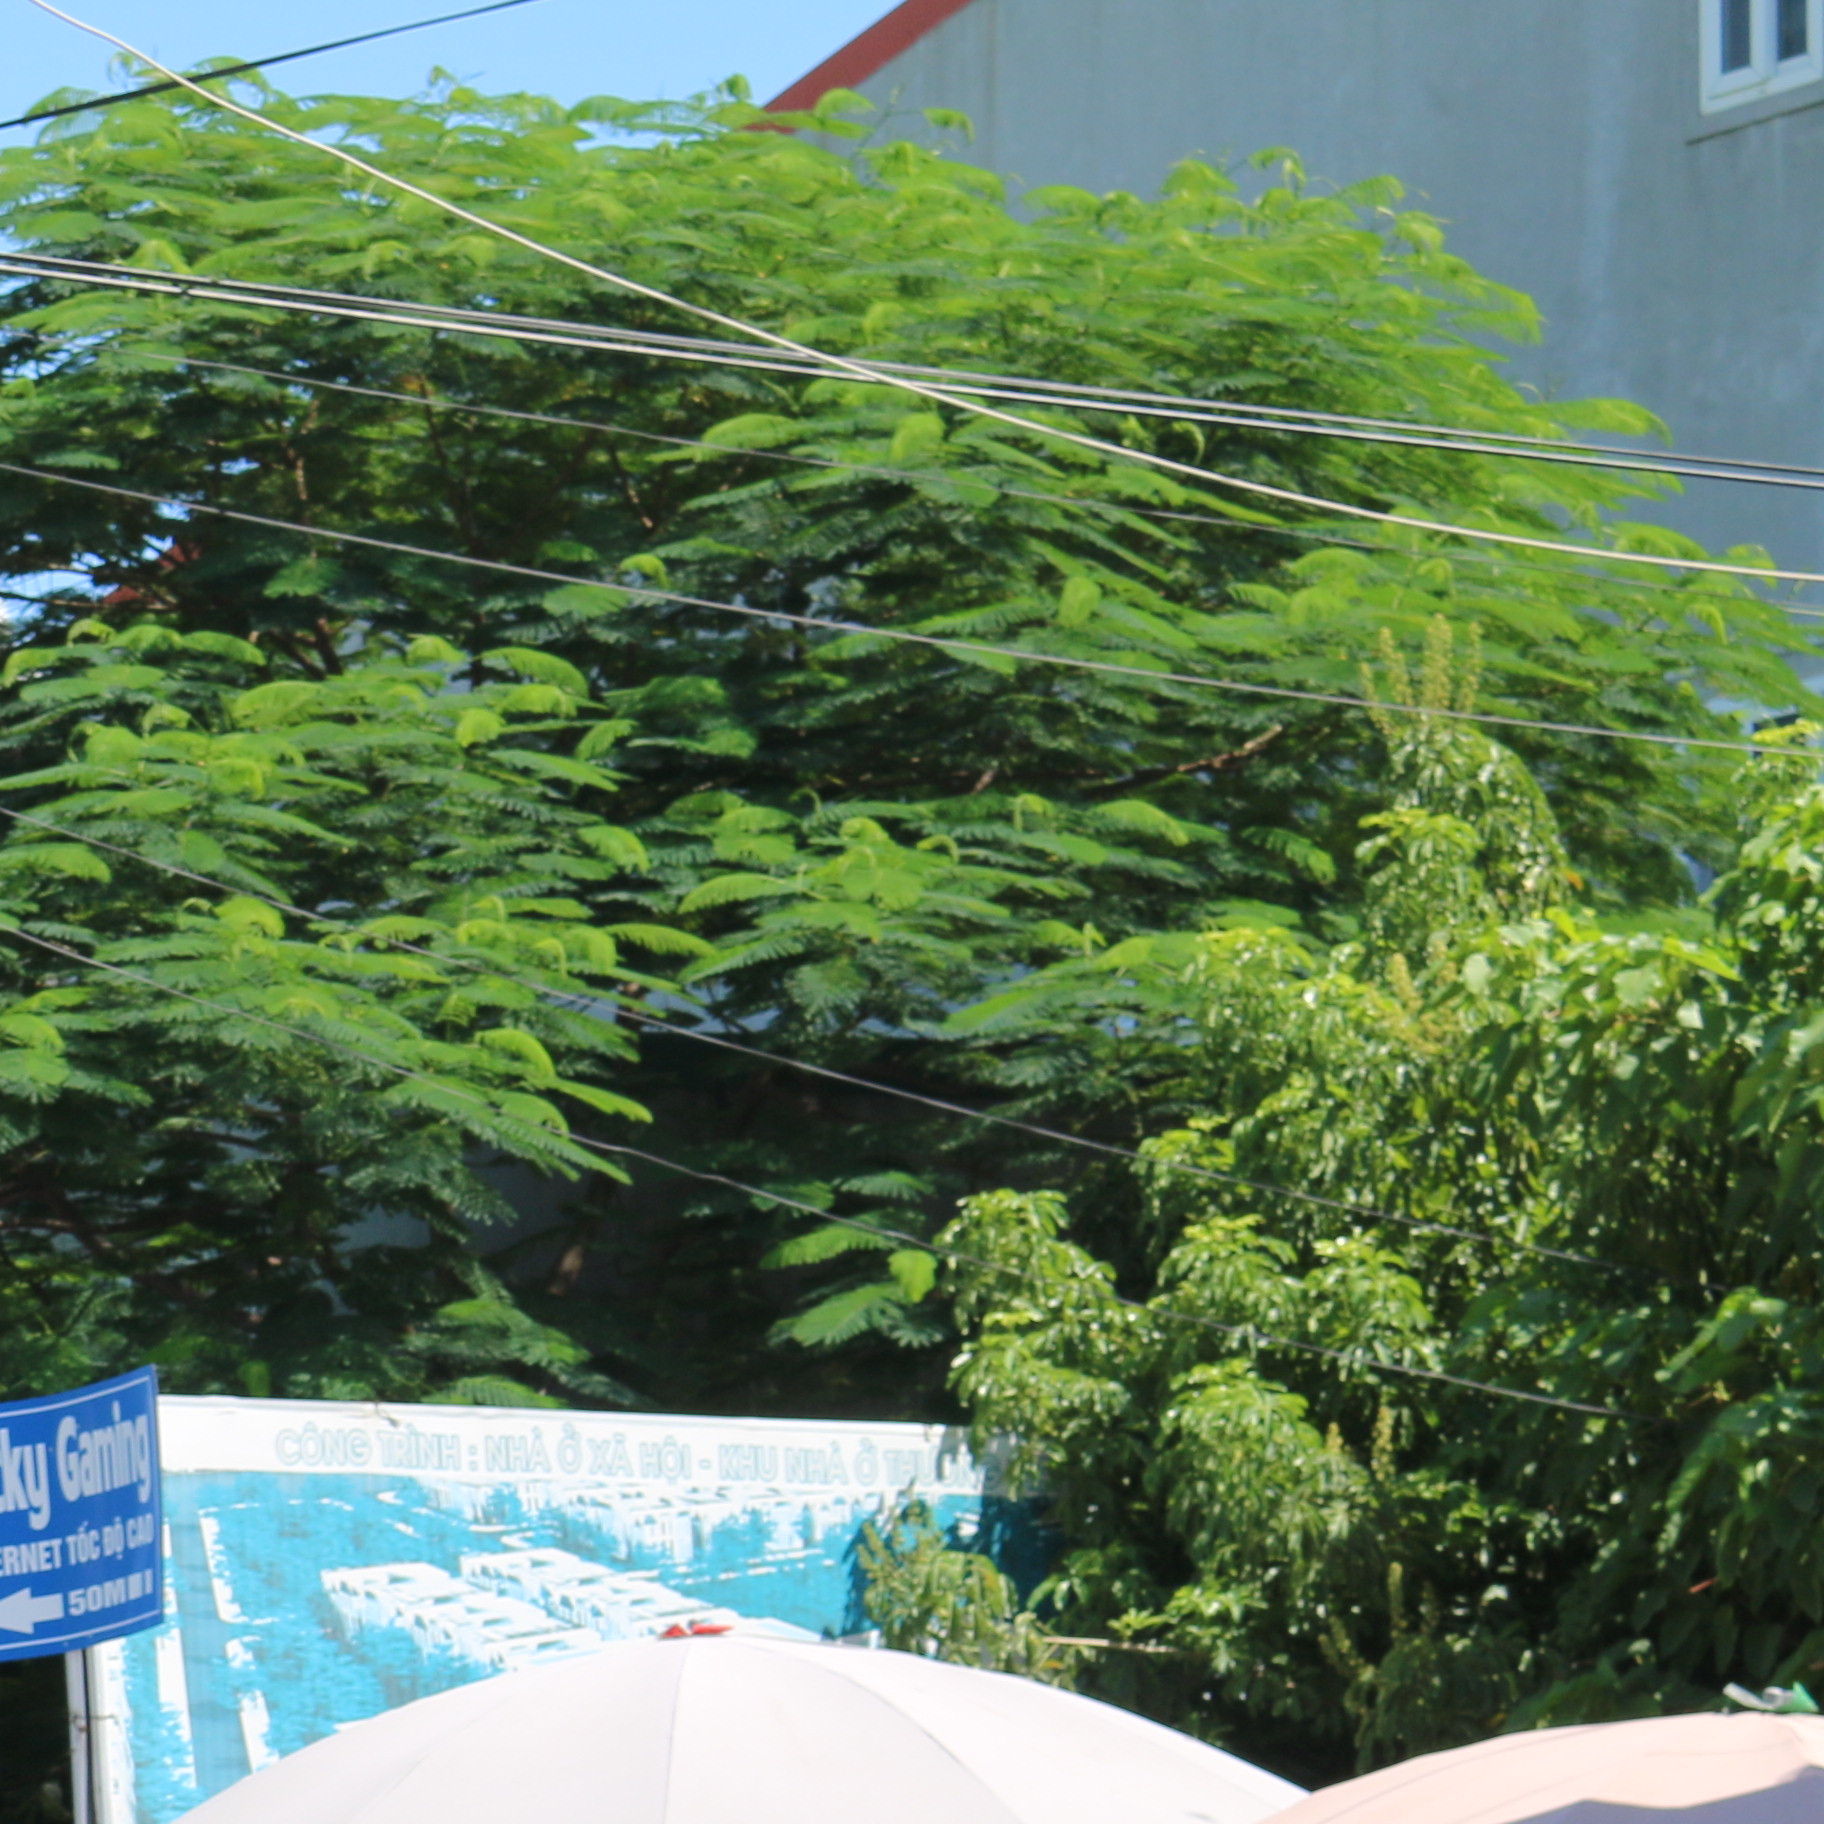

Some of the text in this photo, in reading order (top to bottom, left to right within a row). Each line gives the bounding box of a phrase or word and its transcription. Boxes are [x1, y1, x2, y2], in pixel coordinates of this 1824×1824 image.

[57, 1401, 151, 1503] Gaming
[276, 1421, 372, 1467] CÔNG
[377, 1423, 461, 1471] TRÌNH
[485, 1426, 551, 1472] NHÀ
[558, 1423, 582, 1474] Ở
[588, 1432, 633, 1478] XÃ
[639, 1436, 691, 1484] HỘI
[719, 1445, 777, 1482] KHU
[786, 1439, 848, 1486] NHÀ
[855, 1438, 877, 1487] Ở
[66, 1521, 99, 1564] TỐC
[103, 1517, 124, 1559] ĐỘ
[128, 1513, 154, 1548] CAO
